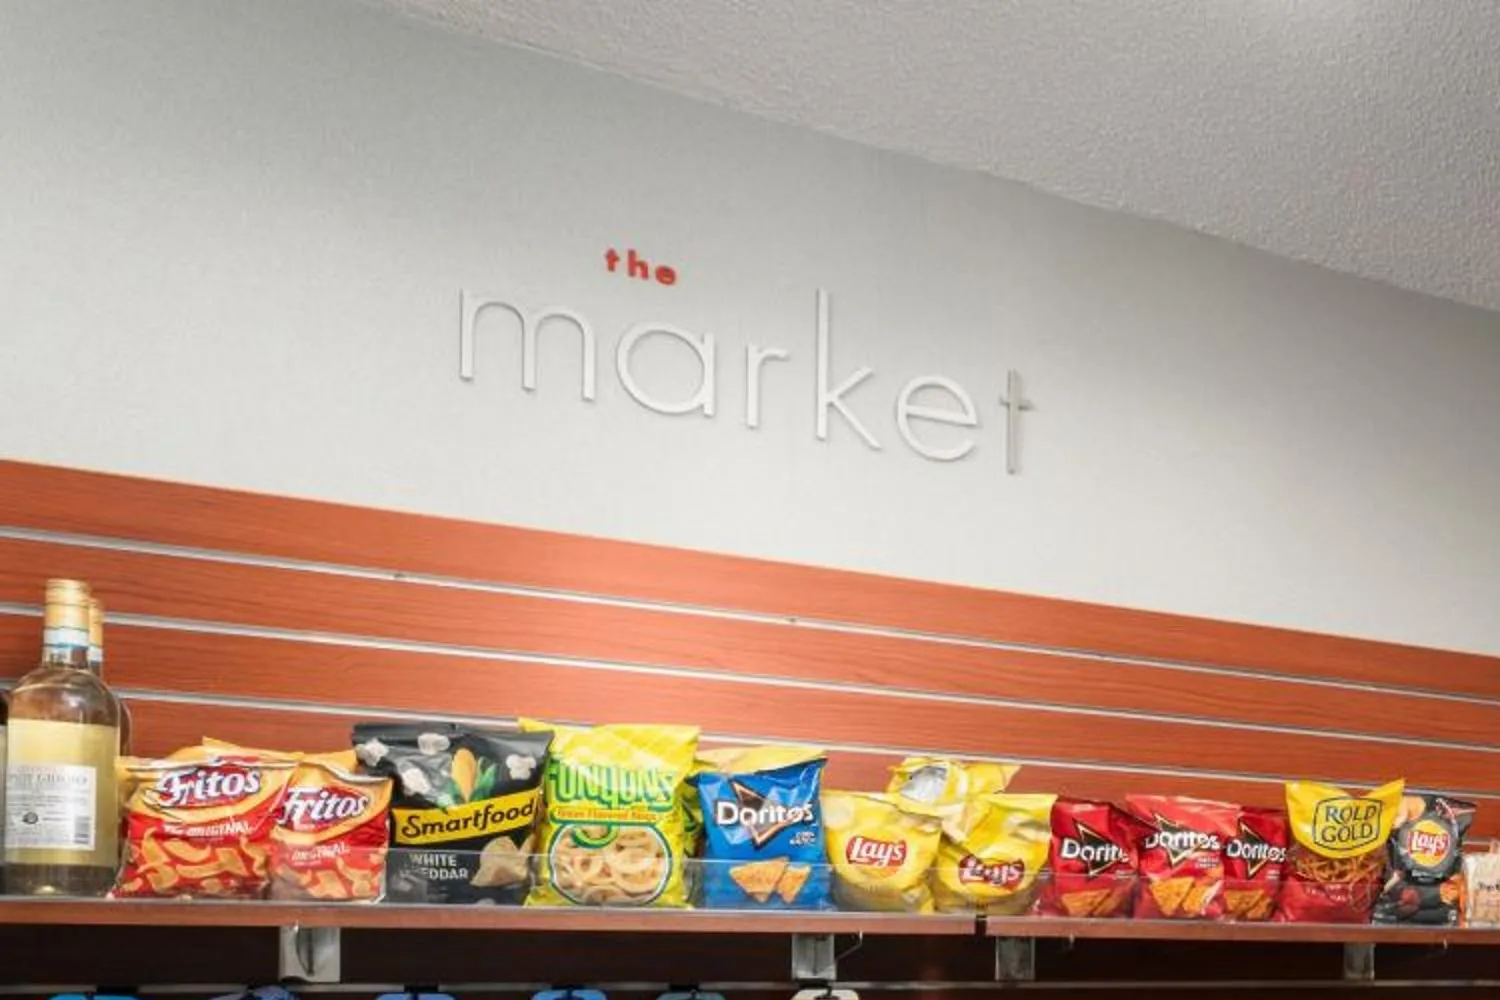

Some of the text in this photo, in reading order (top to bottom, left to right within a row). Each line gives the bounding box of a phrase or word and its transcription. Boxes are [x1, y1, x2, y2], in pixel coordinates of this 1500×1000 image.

[604, 247, 678, 287] the
[458, 286, 1037, 476] market
[154, 765, 262, 807] Fritos
[279, 785, 370, 825] Fritos
[715, 799, 814, 827] Doritos
[1324, 804, 1377, 825] ROLD
[401, 802, 535, 839] Smartfood
[1321, 824, 1374, 843] GOLD
[1060, 836, 1130, 863] Dorit
[1145, 830, 1221, 850] Doritos
[1226, 838, 1287, 863] Doritos
[410, 853, 458, 867] WHITE
